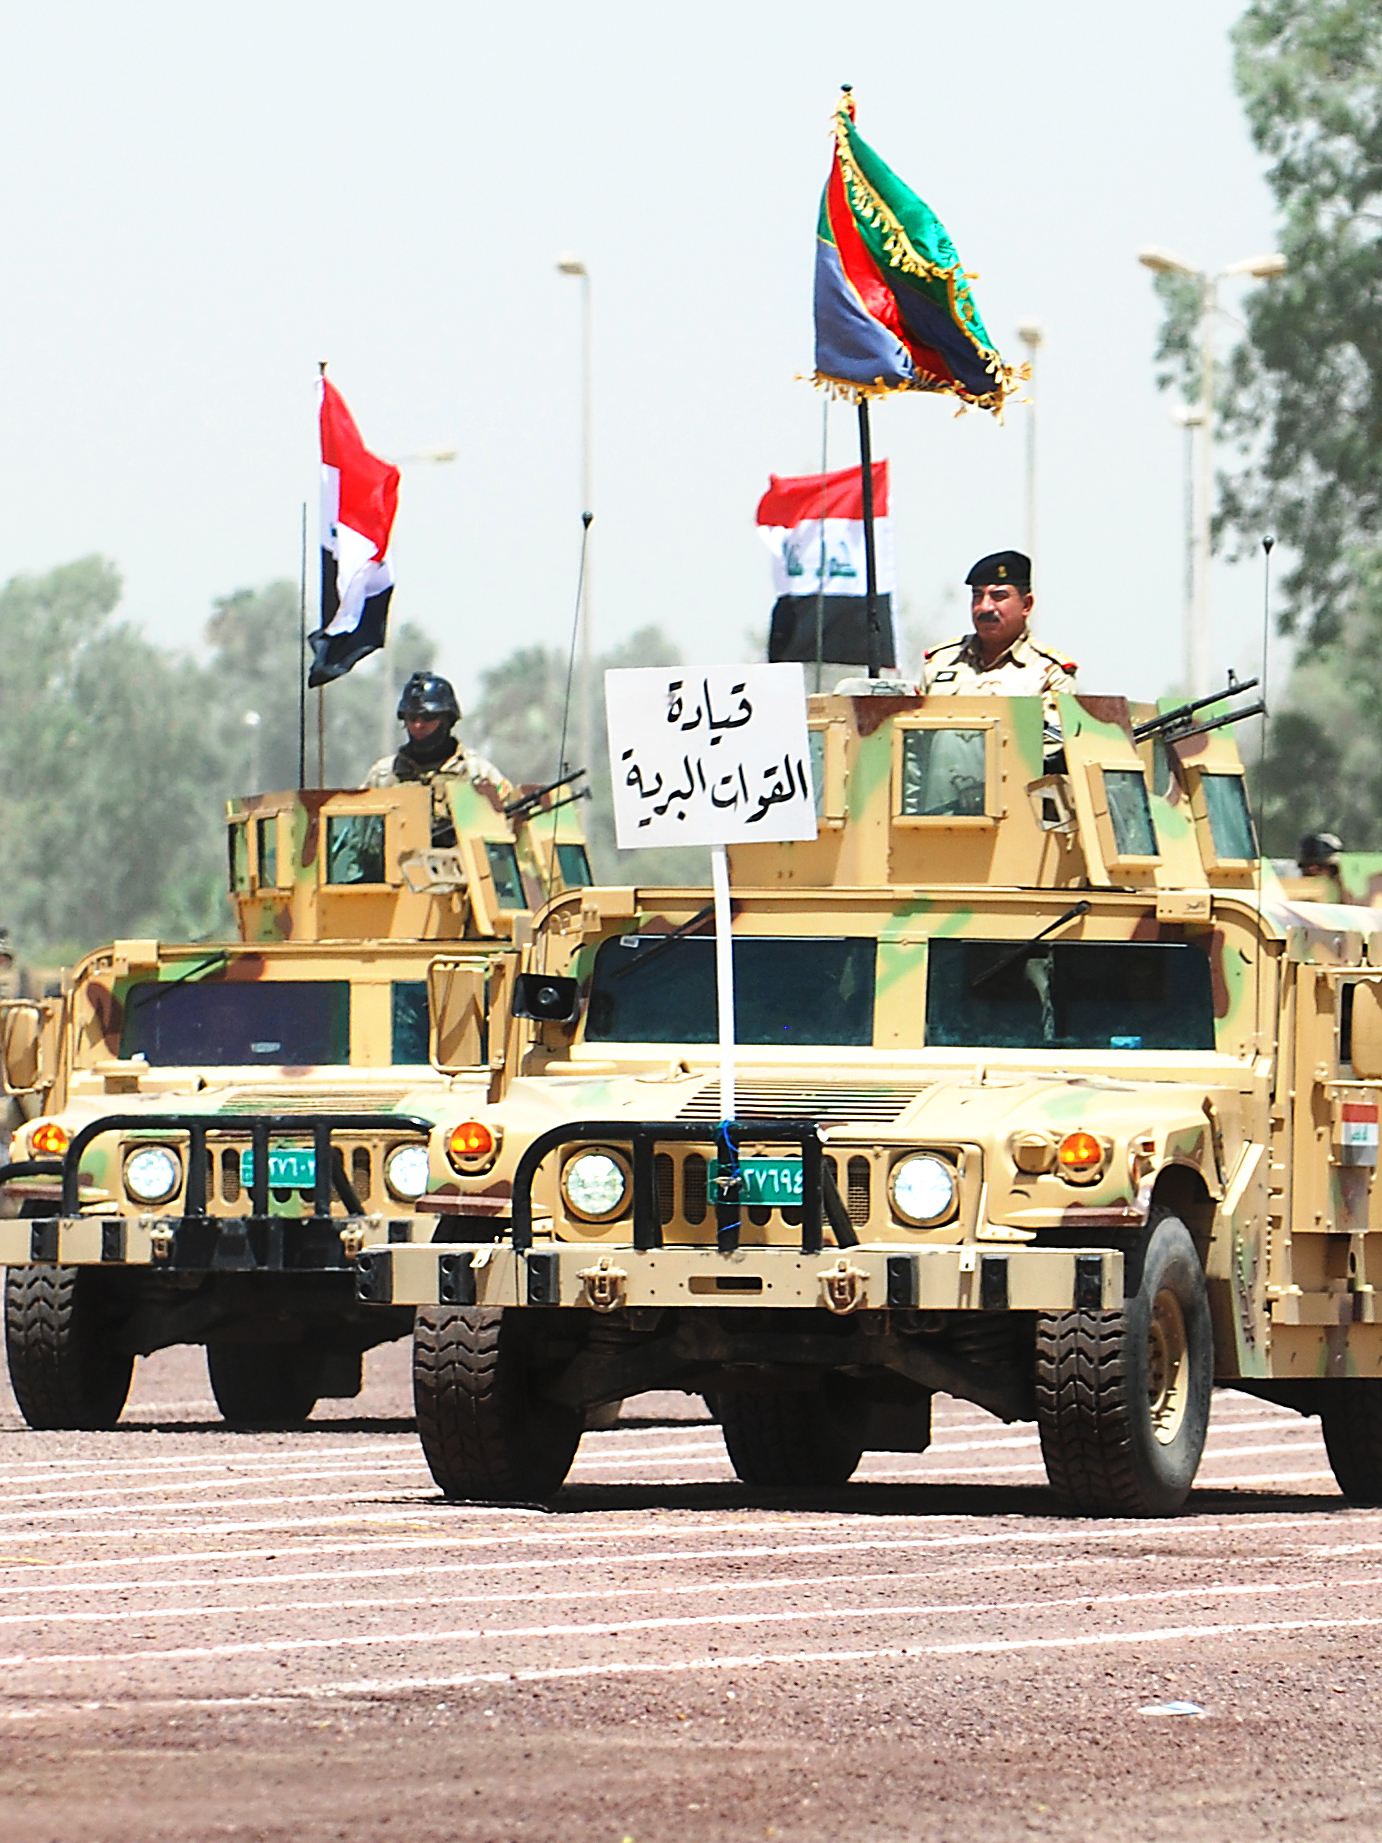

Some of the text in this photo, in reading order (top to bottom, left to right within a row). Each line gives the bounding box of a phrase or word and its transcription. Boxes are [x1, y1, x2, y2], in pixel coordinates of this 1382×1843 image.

[667, 677, 753, 747] قيادة
[621, 748, 809, 828] القوات البرية
